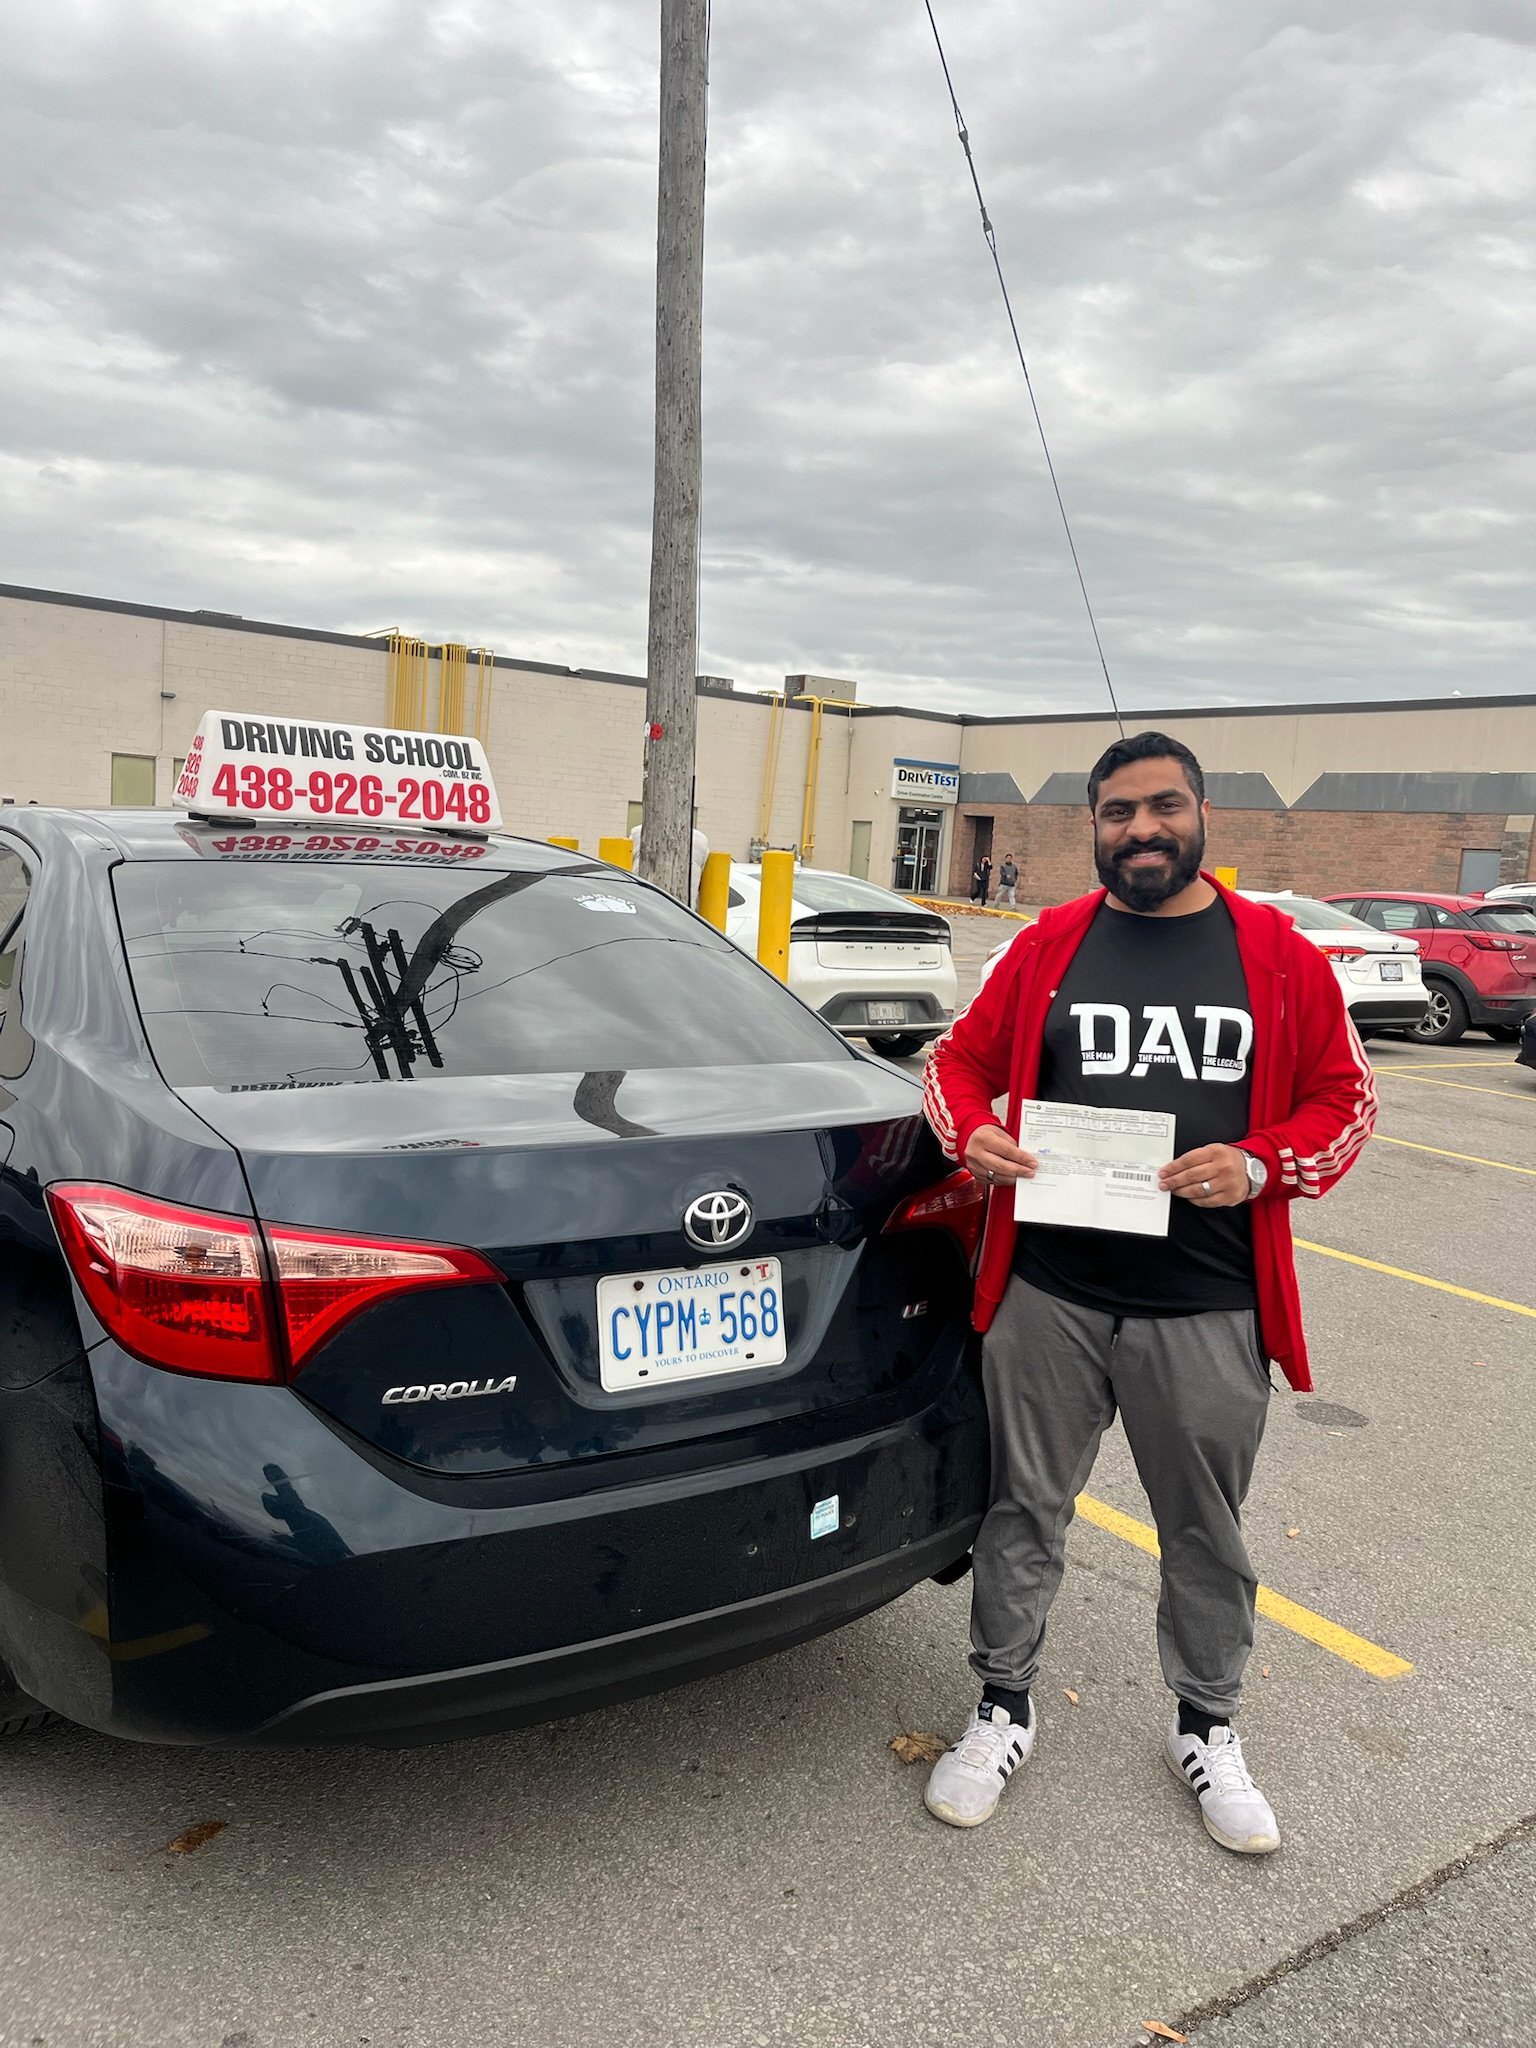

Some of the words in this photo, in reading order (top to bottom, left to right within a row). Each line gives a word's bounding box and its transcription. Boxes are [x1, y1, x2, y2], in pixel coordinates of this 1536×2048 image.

[193, 735, 204, 750] 438
[220, 719, 354, 761] DRIVING
[363, 733, 481, 771] SCHOOL
[185, 752, 202, 774] 926
[177, 774, 199, 798] 2048
[212, 763, 490, 824] 438-926-2048
[1069, 1003, 1254, 1082] DAD
[1081, 1051, 1095, 1060] THE
[1138, 1054, 1153, 1063] THE
[1154, 1055, 1176, 1064] MYTH
[1203, 1056, 1217, 1067] THE
[1217, 1058, 1243, 1070] LEGEND
[658, 1272, 729, 1294] ONTARIO
[612, 1298, 697, 1360] CYPM
[720, 1288, 778, 1343] 568
[655, 1357, 682, 1367] YOURS
[686, 1354, 697, 1363] TO
[700, 1347, 739, 1360] DISCOVER
[382, 1376, 517, 1404] COROLLA
